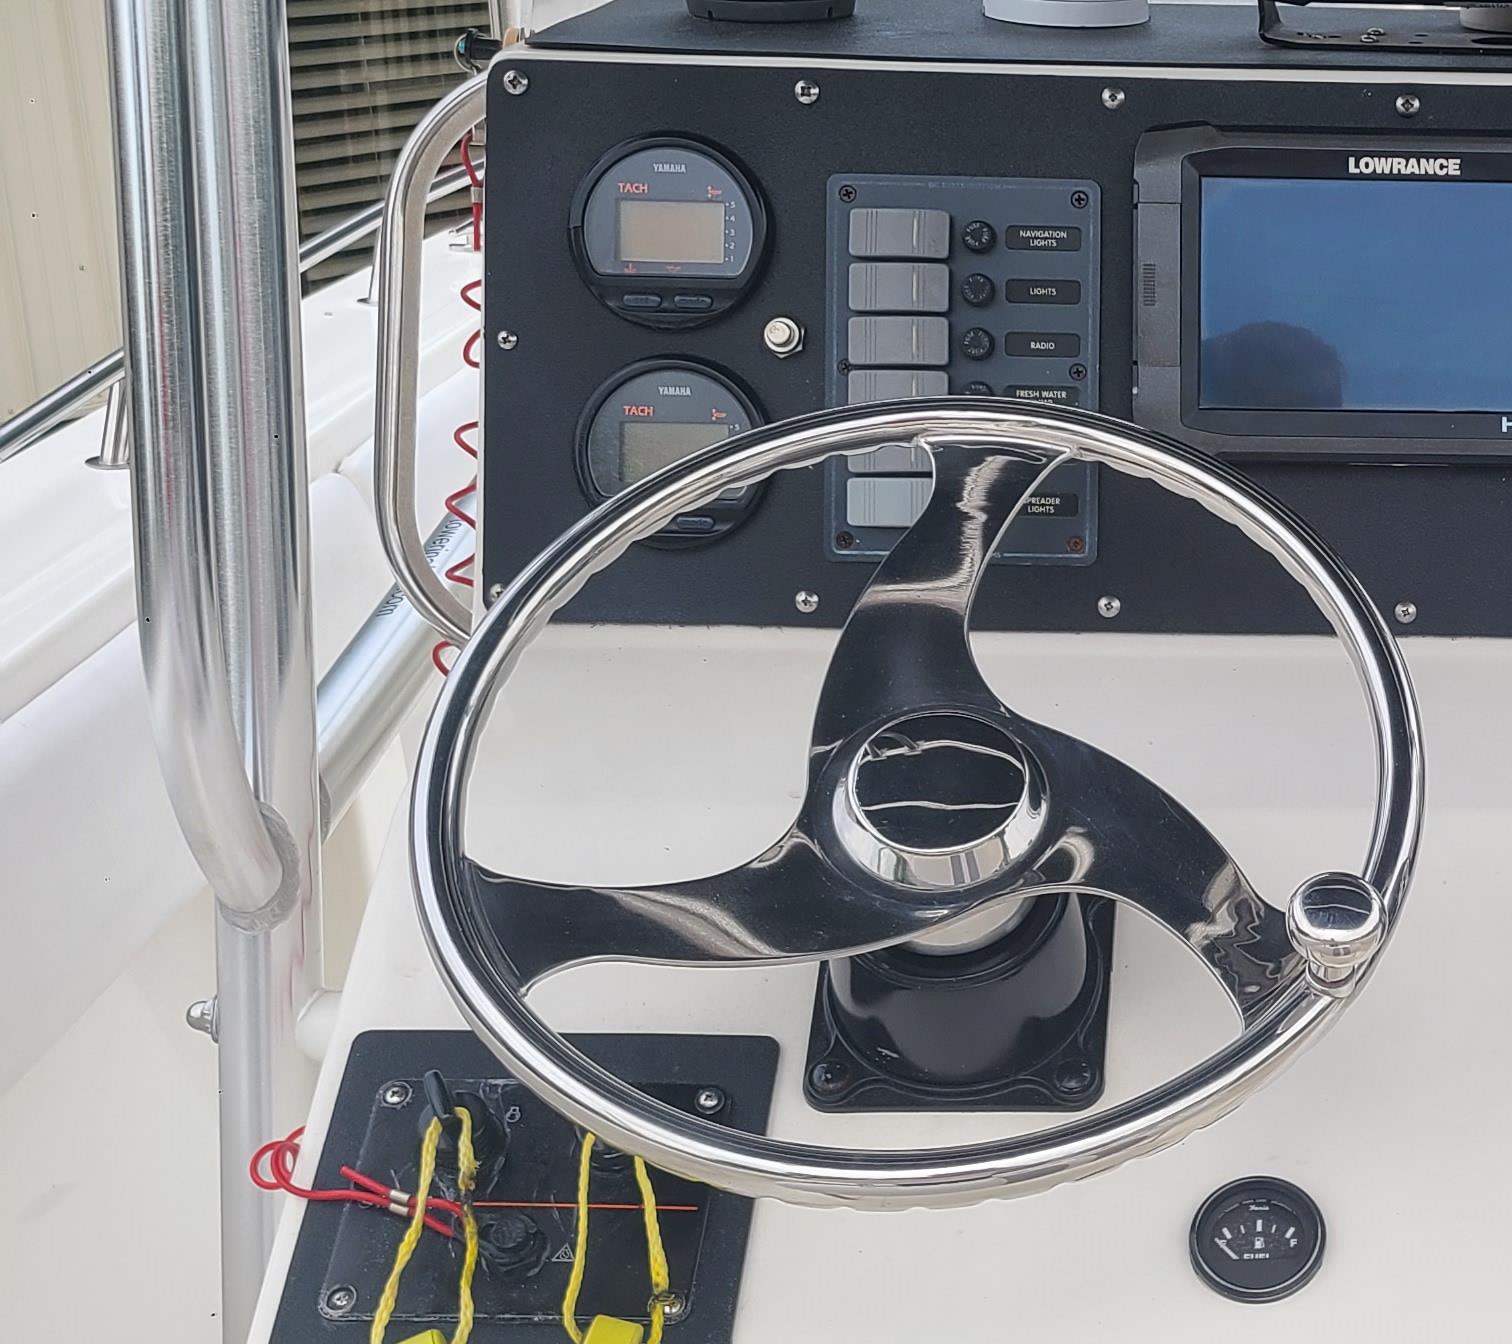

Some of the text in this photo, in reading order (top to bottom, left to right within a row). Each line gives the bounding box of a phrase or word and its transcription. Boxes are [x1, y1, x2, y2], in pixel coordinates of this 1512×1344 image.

[653, 163, 687, 173] YAMAHA
[1348, 156, 1461, 176] LOWRANCE
[618, 182, 648, 193] TACH
[1019, 230, 1068, 239] NAVIGATION
[1029, 239, 1057, 247] LIGHTS
[1029, 287, 1057, 296] LIGHTS
[1030, 341, 1056, 350] RADIO
[658, 386, 692, 396] YAMAHA
[1016, 389, 1067, 399] FRESH WATER
[623, 405, 655, 416] TACH
[1027, 505, 1055, 513] LIGHTS
[1289, 1238, 1298, 1248] F
